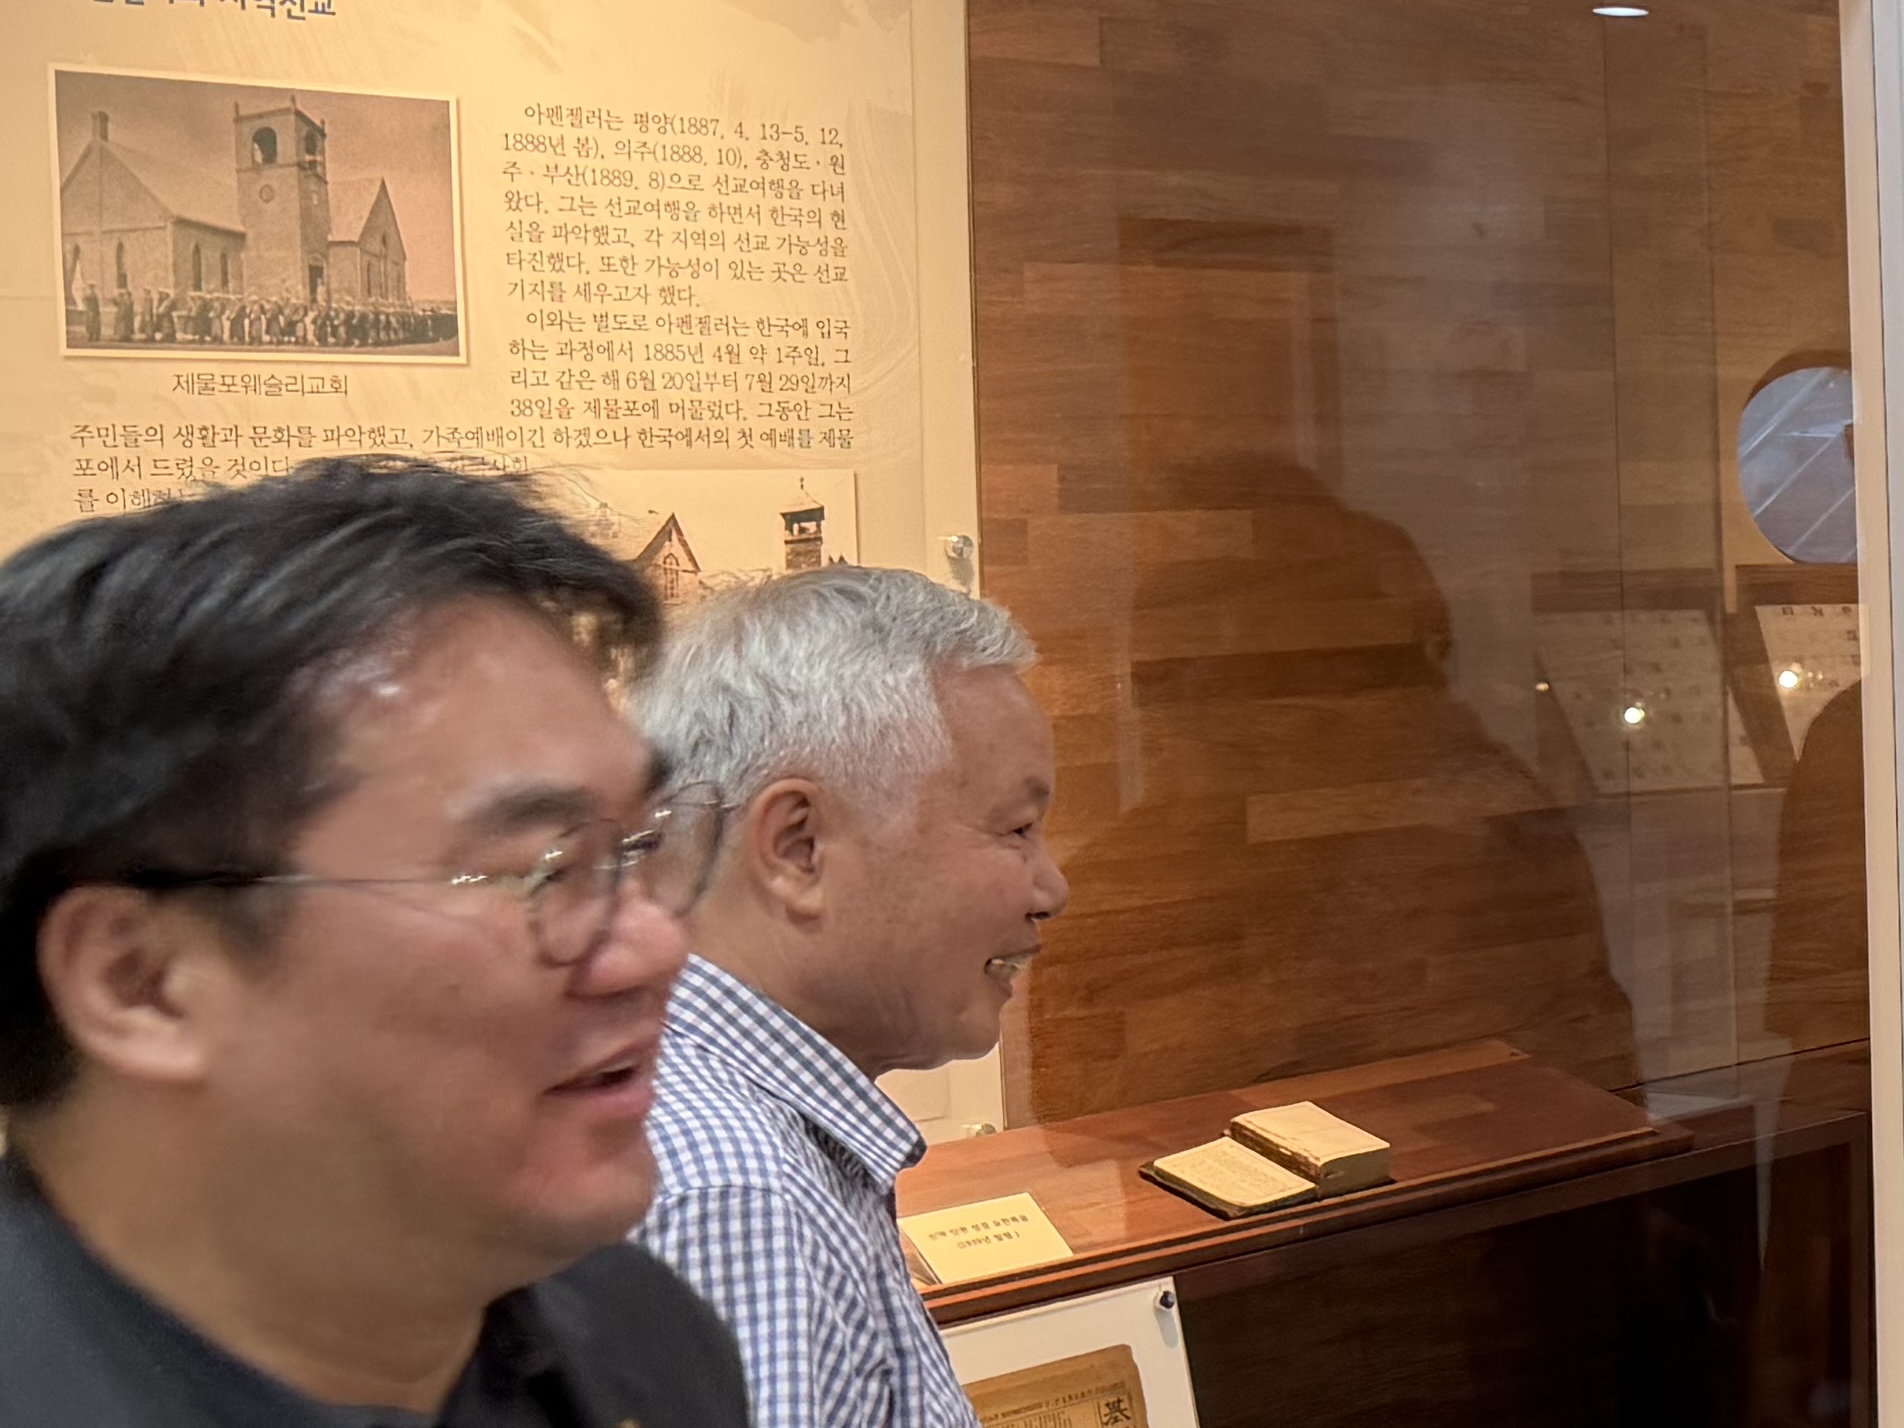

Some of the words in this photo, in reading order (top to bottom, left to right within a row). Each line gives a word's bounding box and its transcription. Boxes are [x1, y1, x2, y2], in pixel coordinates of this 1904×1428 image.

[525, 102, 624, 131] 아펜젤러는
[503, 132, 566, 157] 1888년
[648, 169, 705, 192] 8)으로
[712, 174, 804, 201] 선교여행을
[811, 180, 845, 204] 다녀
[504, 190, 549, 214] 왔다.
[558, 194, 598, 217] 그는
[605, 196, 701, 223] 선교여행을
[708, 201, 761, 227] 하면서
[768, 205, 822, 230] 한국의
[830, 208, 847, 231] 현
[506, 219, 545, 243] 실을
[644, 226, 664, 249] 각
[671, 228, 726, 253] 지역의
[734, 231, 770, 253] 선교
[776, 233, 848, 258] 가능성을
[506, 249, 590, 275] 타진했다.
[599, 254, 638, 277] 또한
[644, 255, 719, 281] 가능성이
[728, 258, 765, 282] 있는
[771, 262, 808, 283] 곳은
[814, 263, 848, 284] 선교
[508, 278, 567, 303] 기지를
[573, 281, 651, 305] 세우고자
[659, 284, 700, 308] 했다.
[527, 308, 586, 333] 이와는
[592, 311, 650, 334] 별도로
[655, 313, 750, 337] 아펜젤러는
[756, 315, 809, 339] 한국에
[816, 317, 850, 340] 입국
[509, 337, 549, 361] 하는
[555, 338, 633, 363] 과정에서
[644, 342, 704, 364] 1885년
[713, 343, 743, 365] 4월
[749, 343, 768, 365] 약
[834, 348, 852, 364] 그
[172, 373, 350, 398] 제물포웨슬리교회
[510, 367, 550, 390] 리고
[555, 368, 597, 391] 같은
[602, 369, 620, 391] 해
[626, 369, 656, 392] 6월
[661, 371, 739, 393] 20일부터
[745, 371, 774, 394] 7월
[779, 372, 851, 395] 29일까지
[510, 397, 575, 420] 38일을
[583, 398, 659, 420] 제물포에
[669, 398, 748, 422] 머물렀다.
[757, 399, 812, 422] 그동안
[817, 401, 855, 422] 그는
[70, 423, 164, 449] 주민들의
[173, 424, 244, 449] 생활과
[248, 424, 316, 449] 문화를
[422, 425, 545, 449] 가족예배이긴
[553, 425, 632, 449] 하겠으나
[637, 426, 730, 449] 한국에서의
[737, 427, 754, 449] 첫
[760, 427, 814, 450] 예배를
[819, 427, 854, 450] 제물
[72, 455, 141, 481] 포에서
[75, 488, 100, 513] 를
